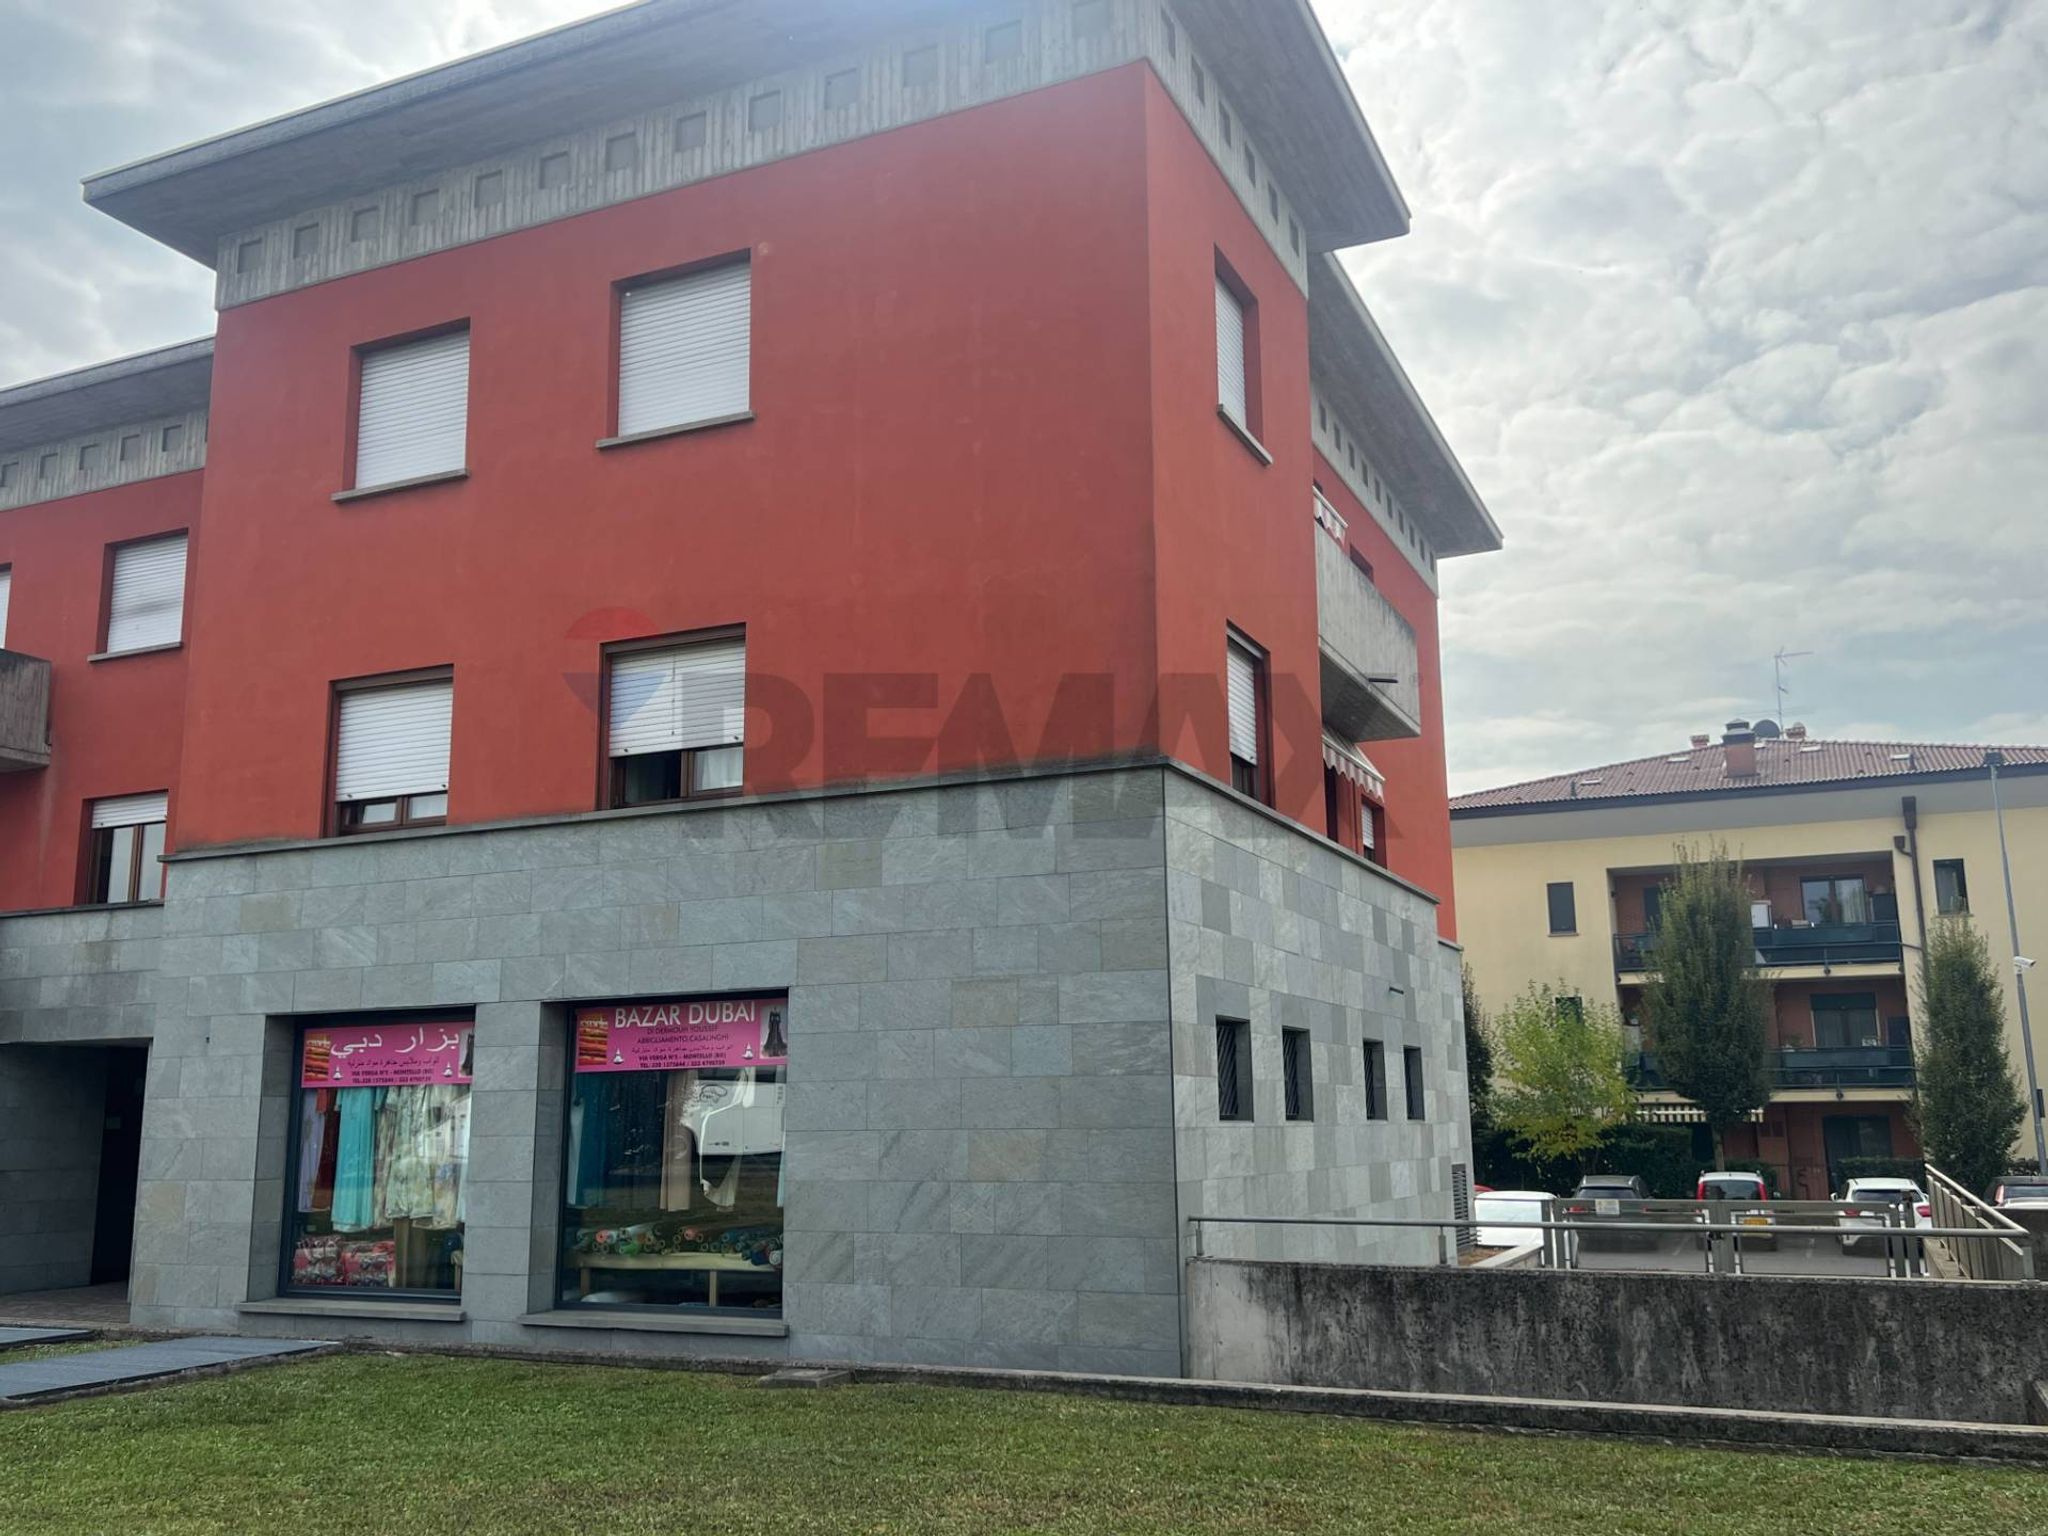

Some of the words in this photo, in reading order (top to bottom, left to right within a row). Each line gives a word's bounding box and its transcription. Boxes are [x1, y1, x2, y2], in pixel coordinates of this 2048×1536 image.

[614, 1005, 681, 1028] BAZAR
[688, 1001, 756, 1024] DUBAI
[331, 1033, 382, 1058] دبي
[395, 1027, 459, 1053] بزار
[688, 1033, 729, 1043] CASALINGHI
